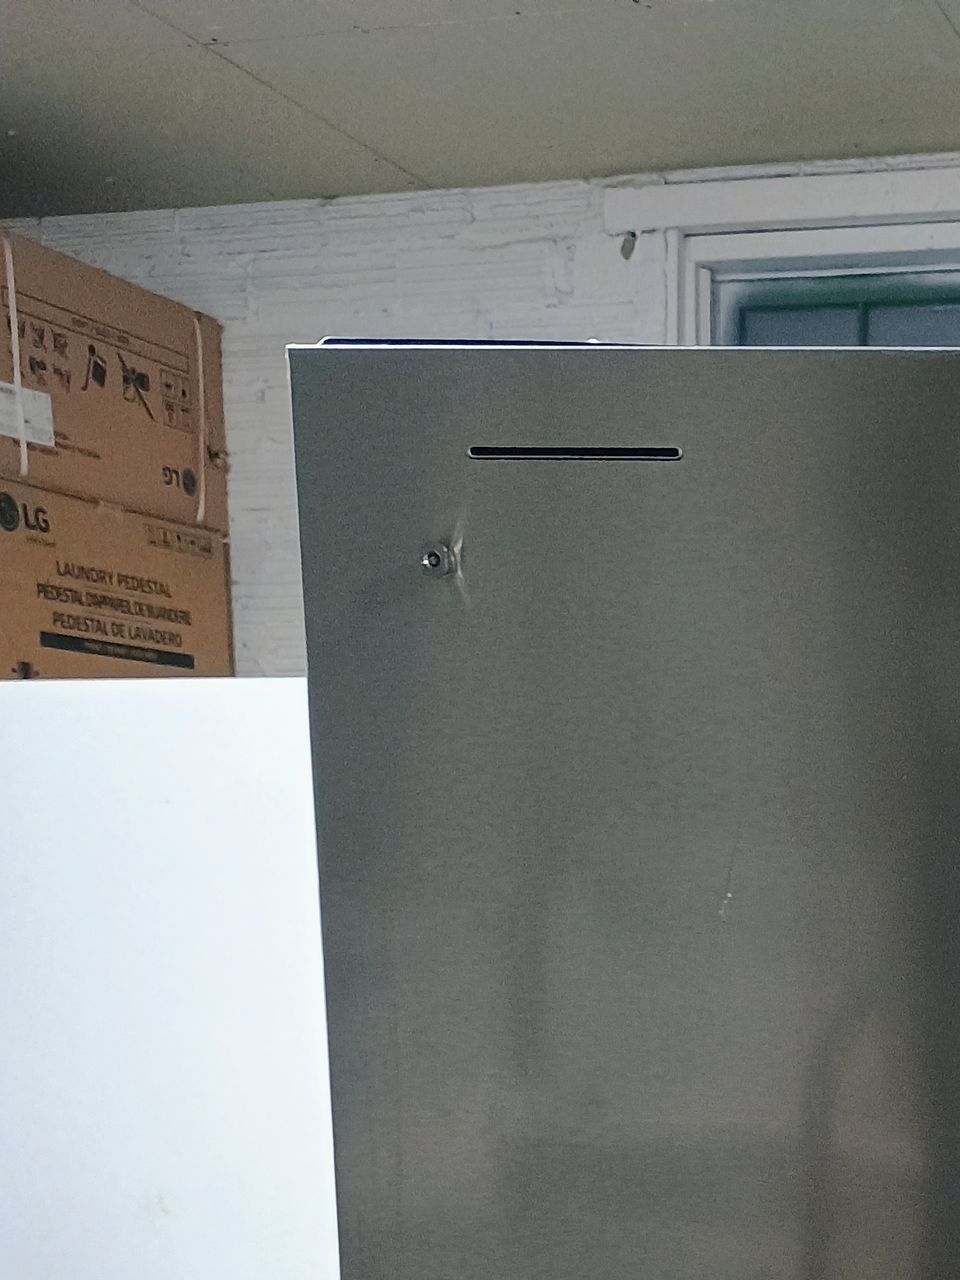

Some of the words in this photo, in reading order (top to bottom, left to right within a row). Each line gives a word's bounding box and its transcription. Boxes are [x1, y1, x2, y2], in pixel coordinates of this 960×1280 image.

[22, 503, 50, 532] LG
[56, 560, 113, 586] LAUNDRY
[117, 573, 172, 598] PEDESTAL
[53, 611, 108, 636] PEDESTAL
[112, 622, 126, 639] DE
[129, 626, 183, 647] LAVADERO
